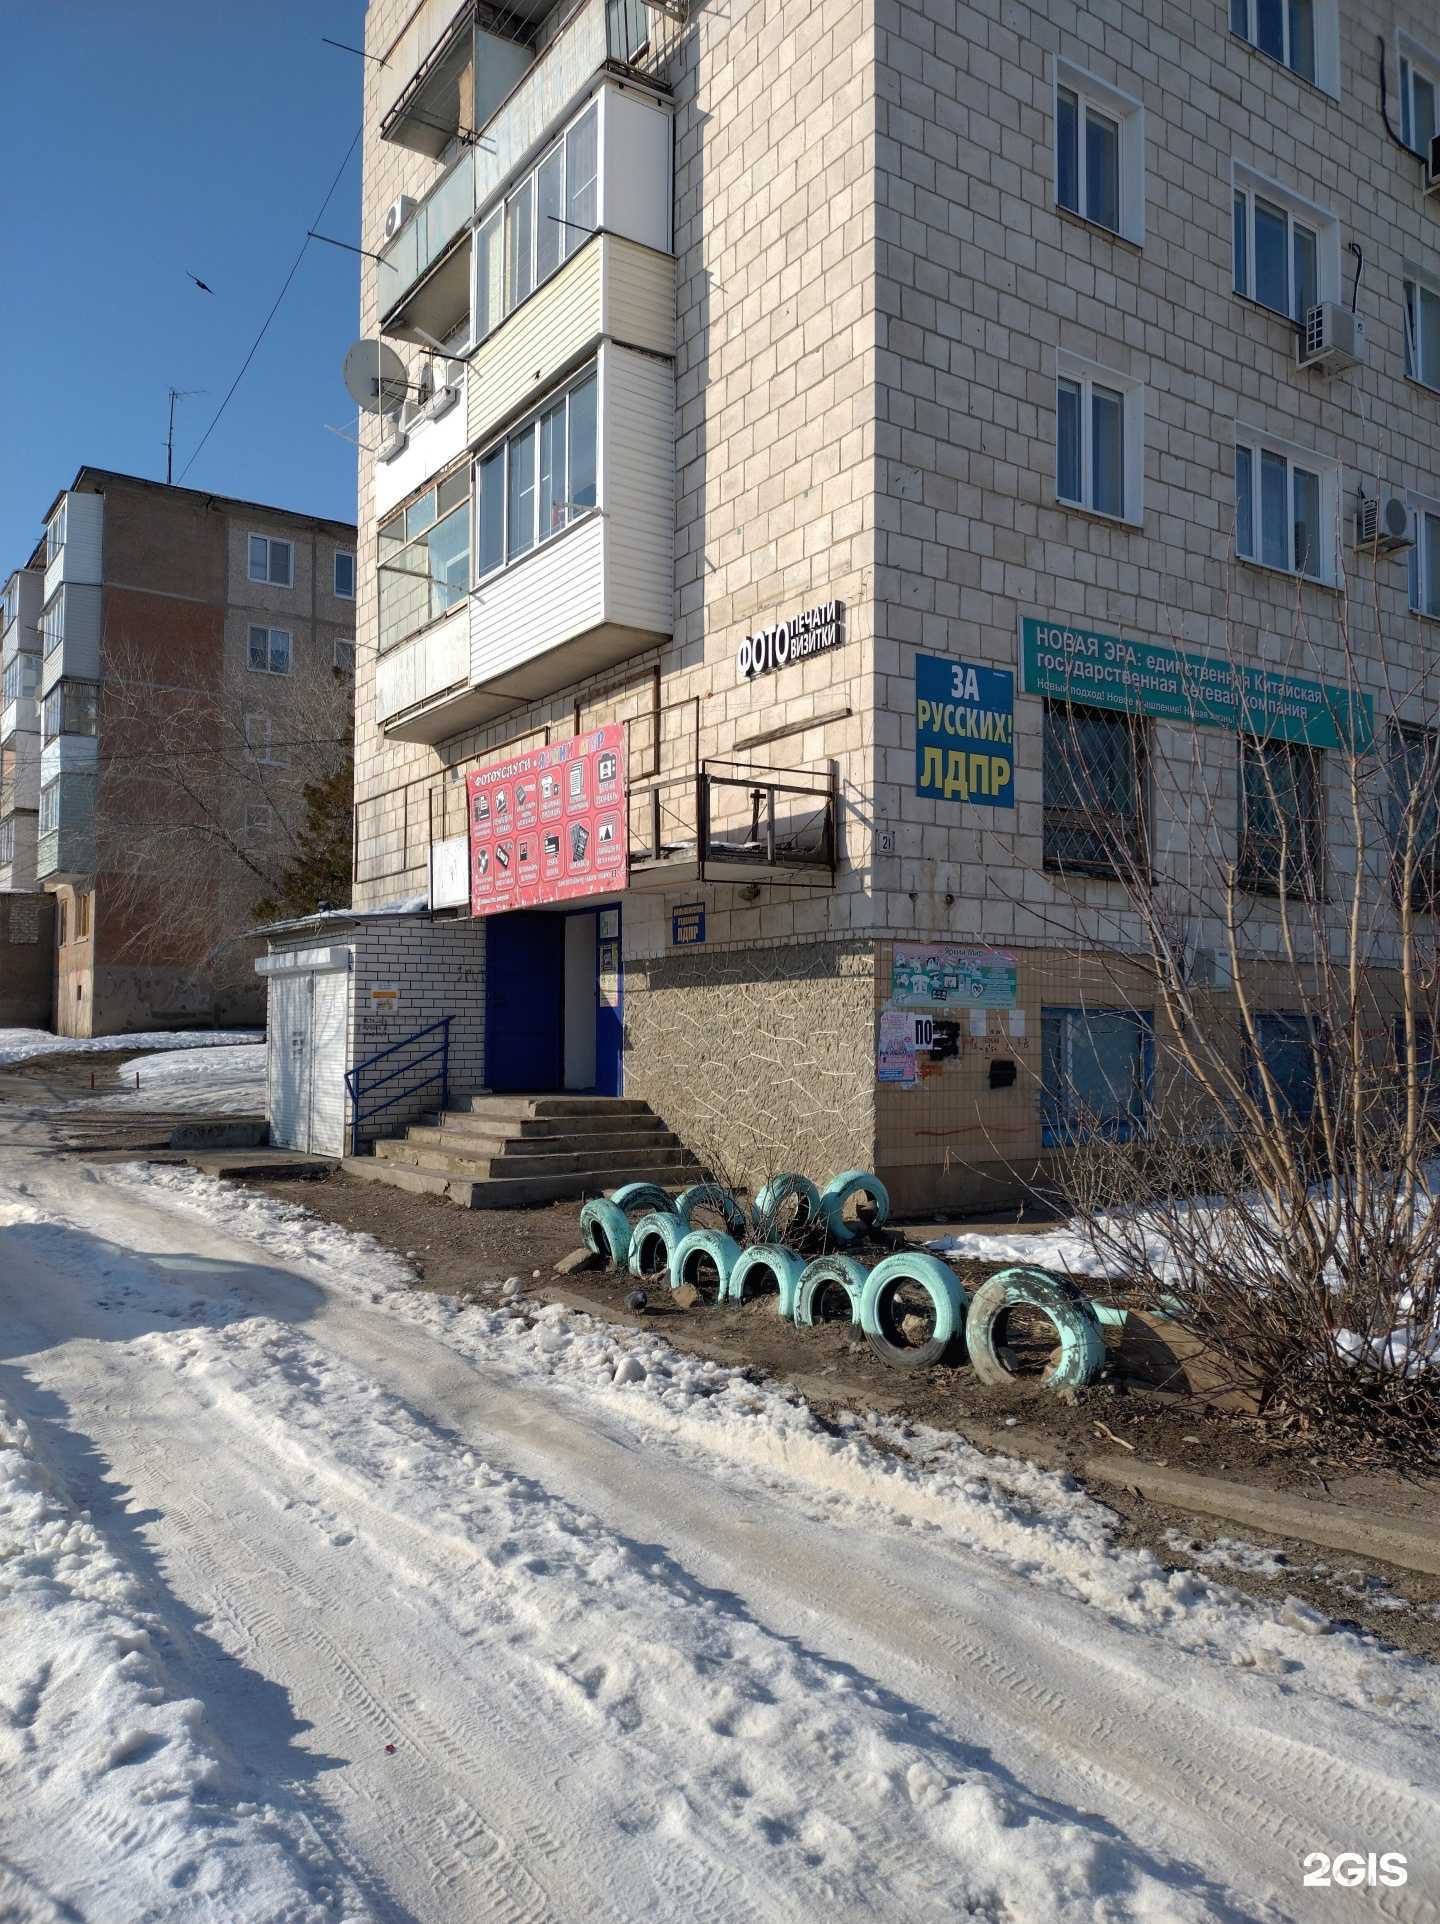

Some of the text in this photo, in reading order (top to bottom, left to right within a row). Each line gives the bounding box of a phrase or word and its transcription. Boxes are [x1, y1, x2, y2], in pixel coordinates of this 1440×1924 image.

[791, 599, 836, 637] ПЕЧАТИ
[737, 622, 790, 678] ФОТО
[791, 623, 836, 659] ВИЗИТКИ
[951, 664, 980, 702] ЗА
[1036, 626, 1098, 657] НОВАЯ
[1104, 640, 1142, 667] ЭРА:
[1254, 674, 1323, 705] Китайская
[1071, 687, 1104, 701] подход!
[918, 698, 1013, 744] РУССКИХ!
[920, 746, 1011, 800] ЛДПР
